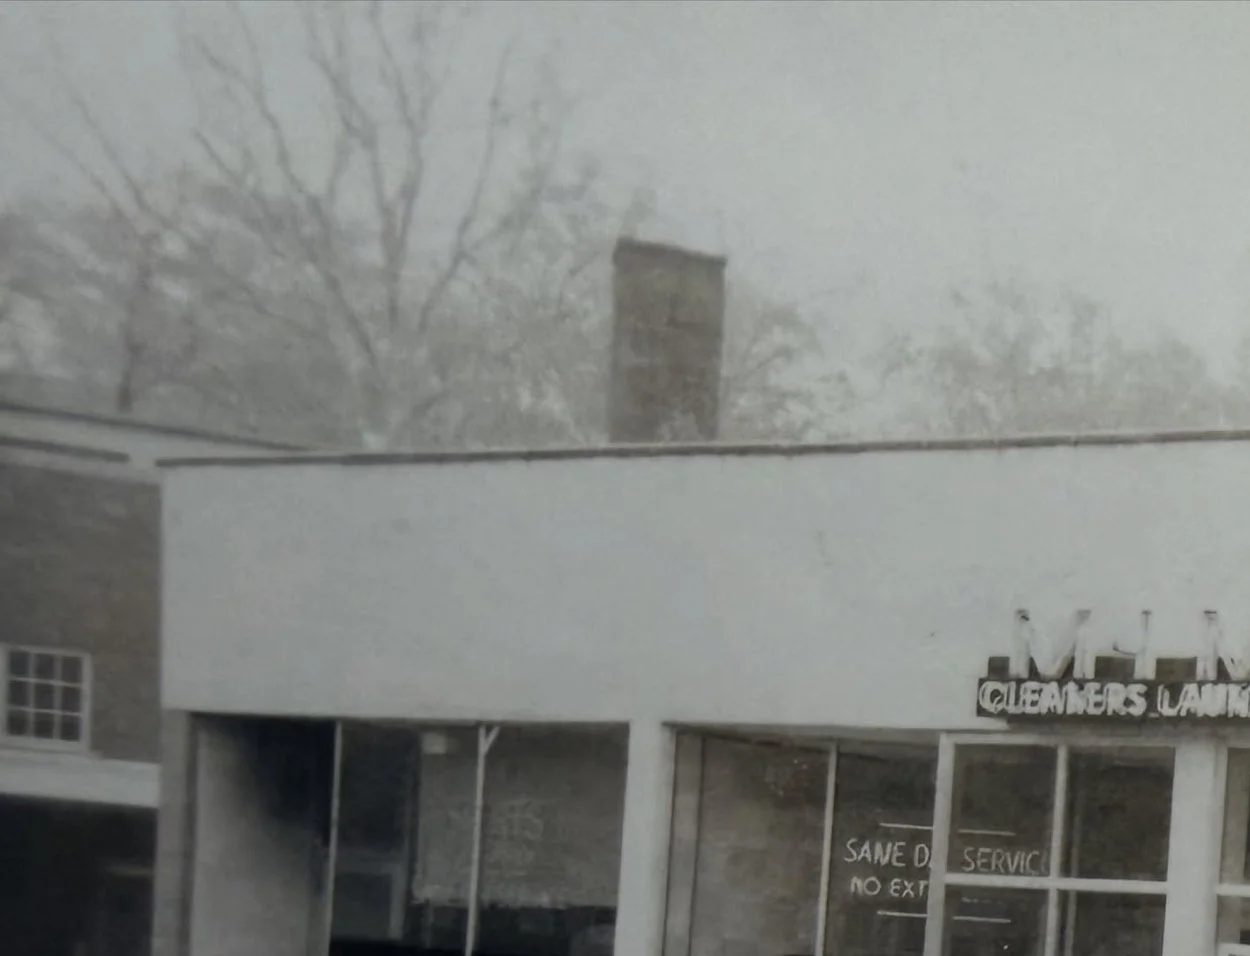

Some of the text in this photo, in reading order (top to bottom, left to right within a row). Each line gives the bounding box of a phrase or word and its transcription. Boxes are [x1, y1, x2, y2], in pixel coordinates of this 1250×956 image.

[979, 680, 1147, 716] CLEANERS
[850, 875, 930, 898] NO EXT
